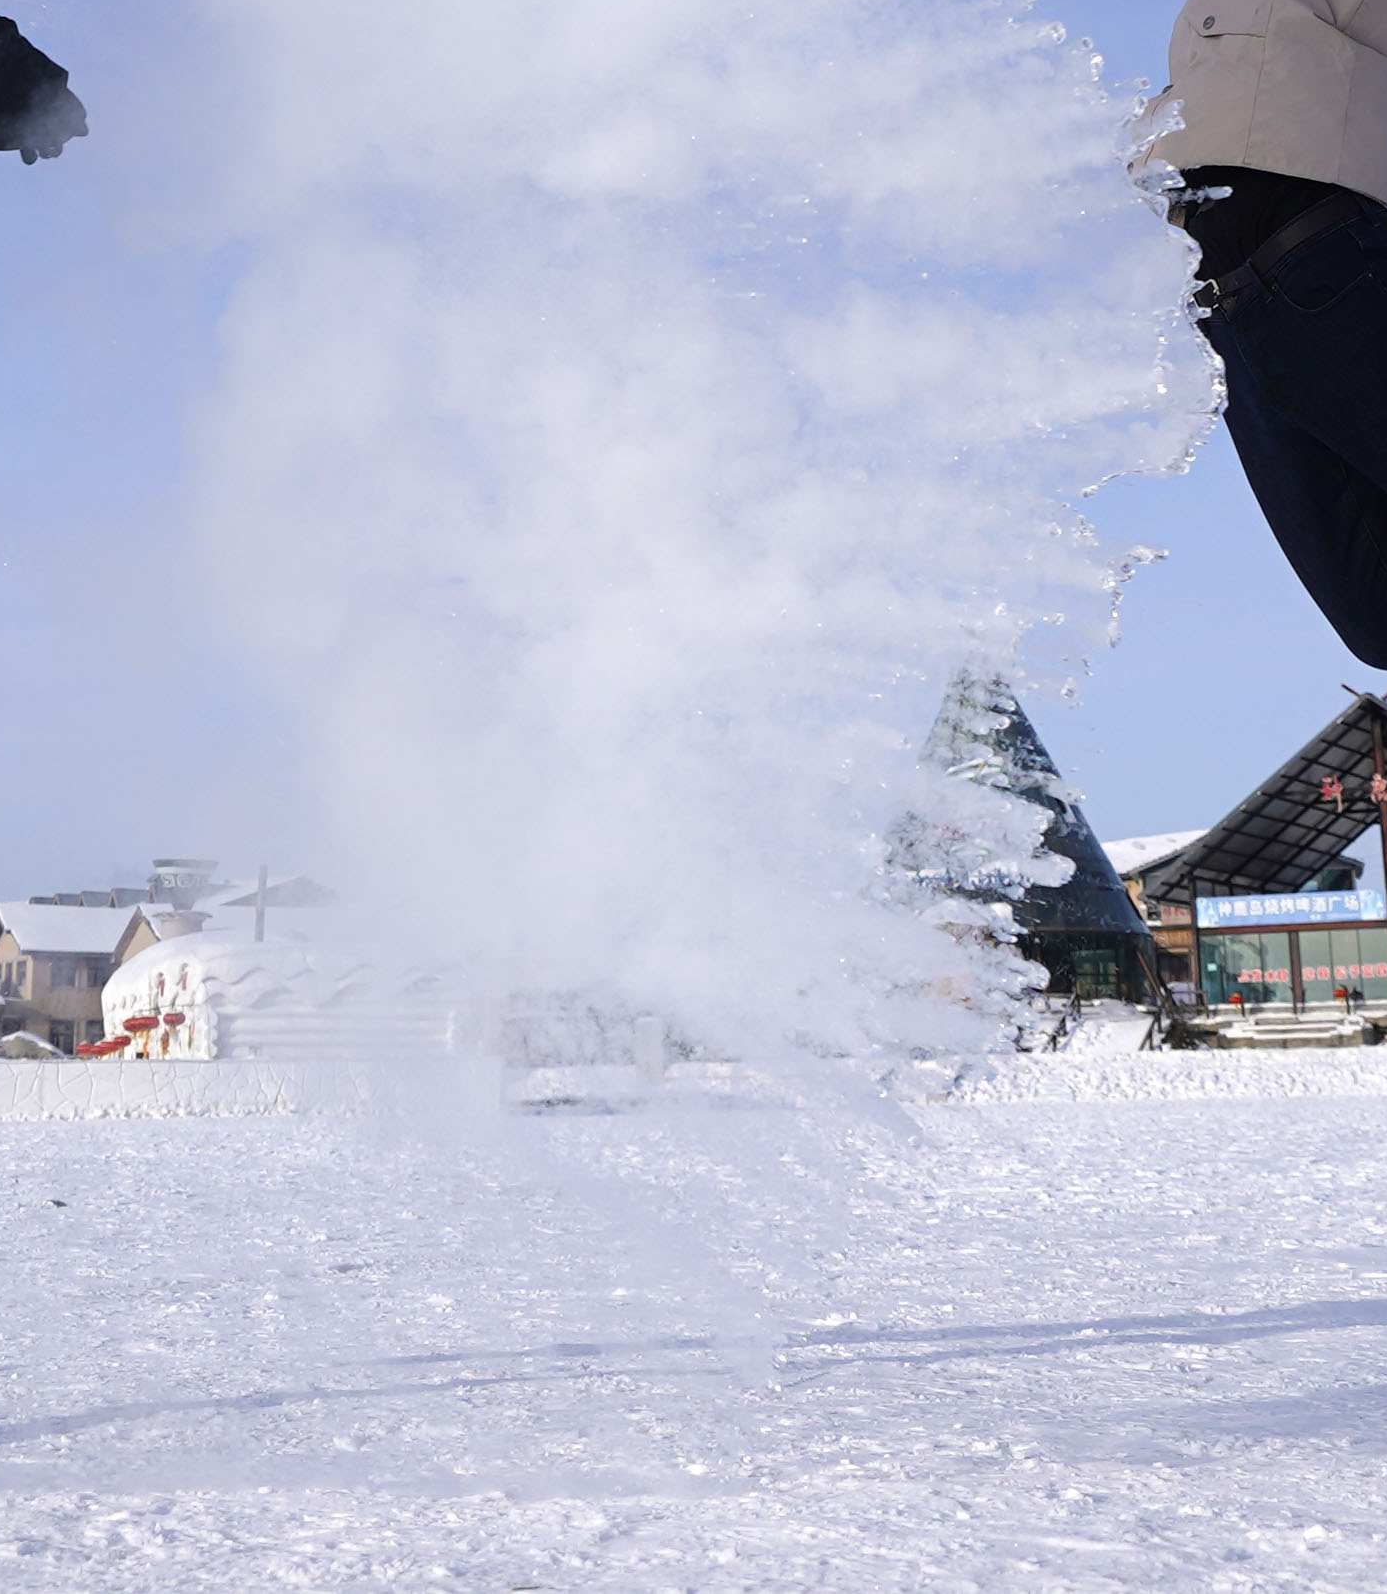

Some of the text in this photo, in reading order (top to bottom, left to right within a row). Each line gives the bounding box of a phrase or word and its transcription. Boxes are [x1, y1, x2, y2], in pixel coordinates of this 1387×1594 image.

[1218, 894, 1359, 917] 神鹿岛烧烤啤酒广场
